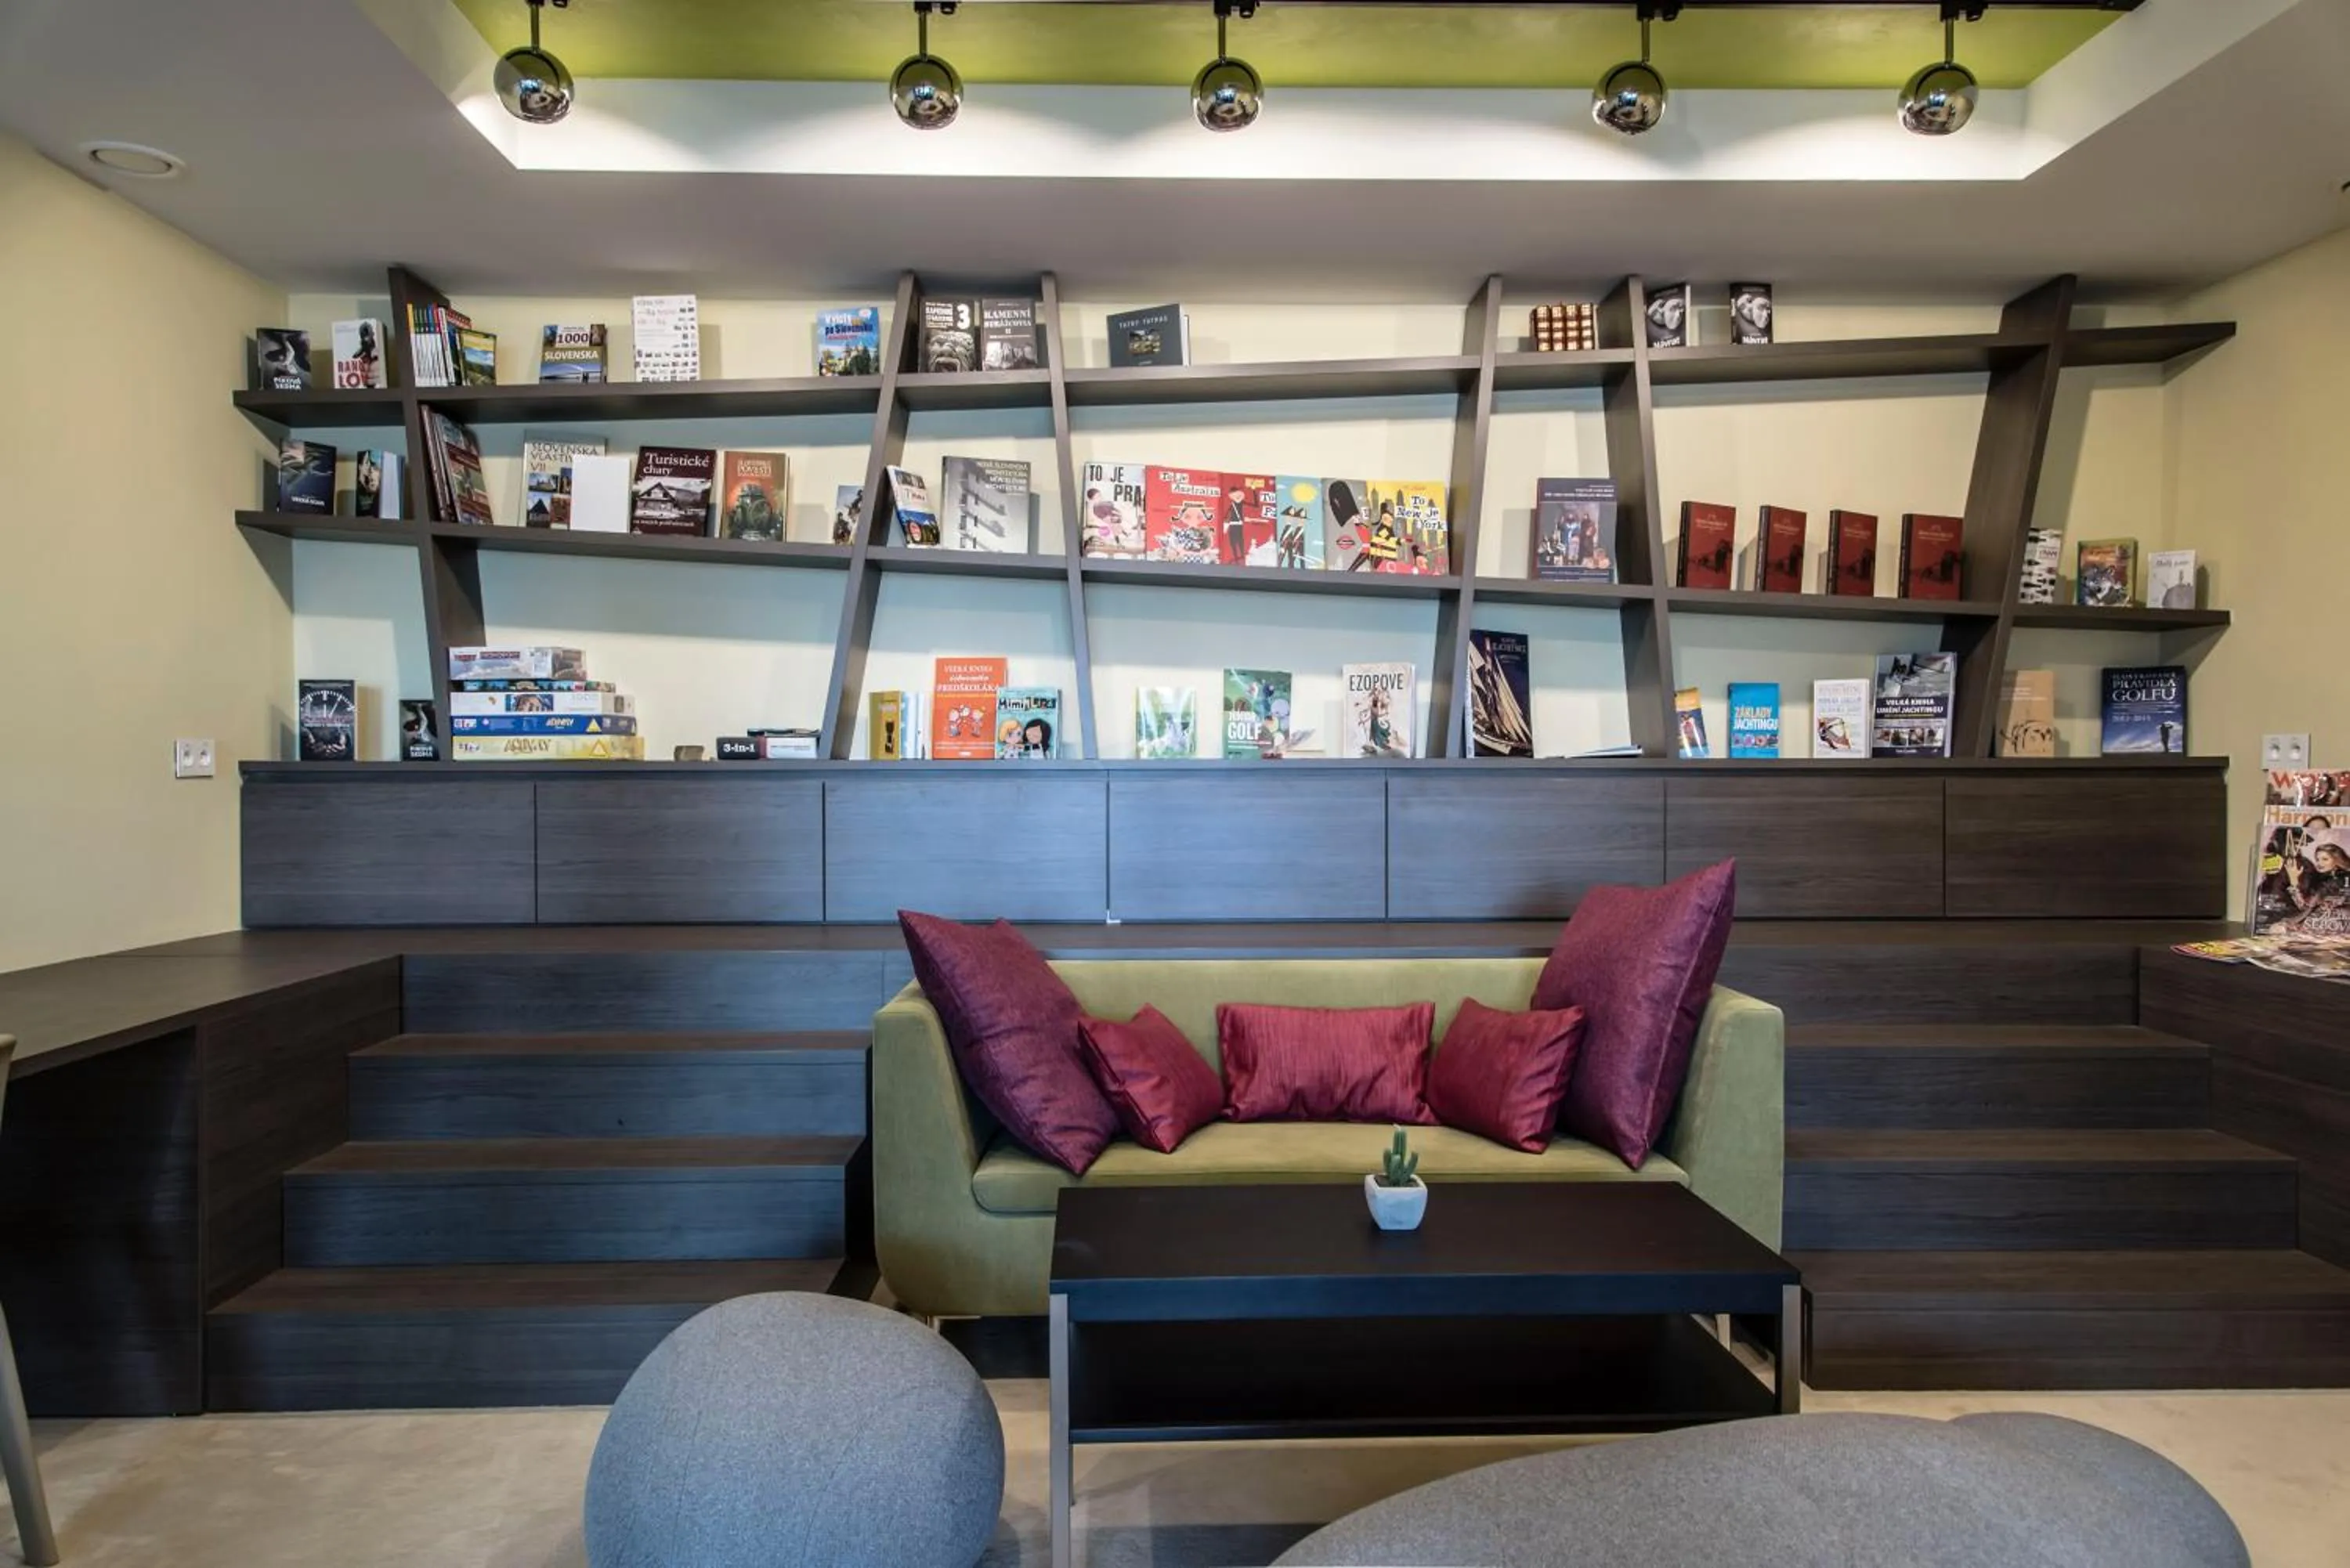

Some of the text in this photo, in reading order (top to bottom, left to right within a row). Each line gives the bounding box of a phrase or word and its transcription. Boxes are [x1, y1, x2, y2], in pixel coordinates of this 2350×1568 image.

[558, 333, 588, 343] 1000
[544, 350, 598, 361] SLOVENSKA
[644, 452, 710, 468] Turistické
[1090, 464, 1124, 483] TO JE
[1411, 496, 1425, 505] To
[1350, 673, 1405, 691] EZOPOVE
[2112, 687, 2176, 702] GOLFU
[1227, 721, 1263, 740] GOLF
[1733, 718, 1778, 730] JACHTINGU
[723, 743, 756, 753] 3-in-1
